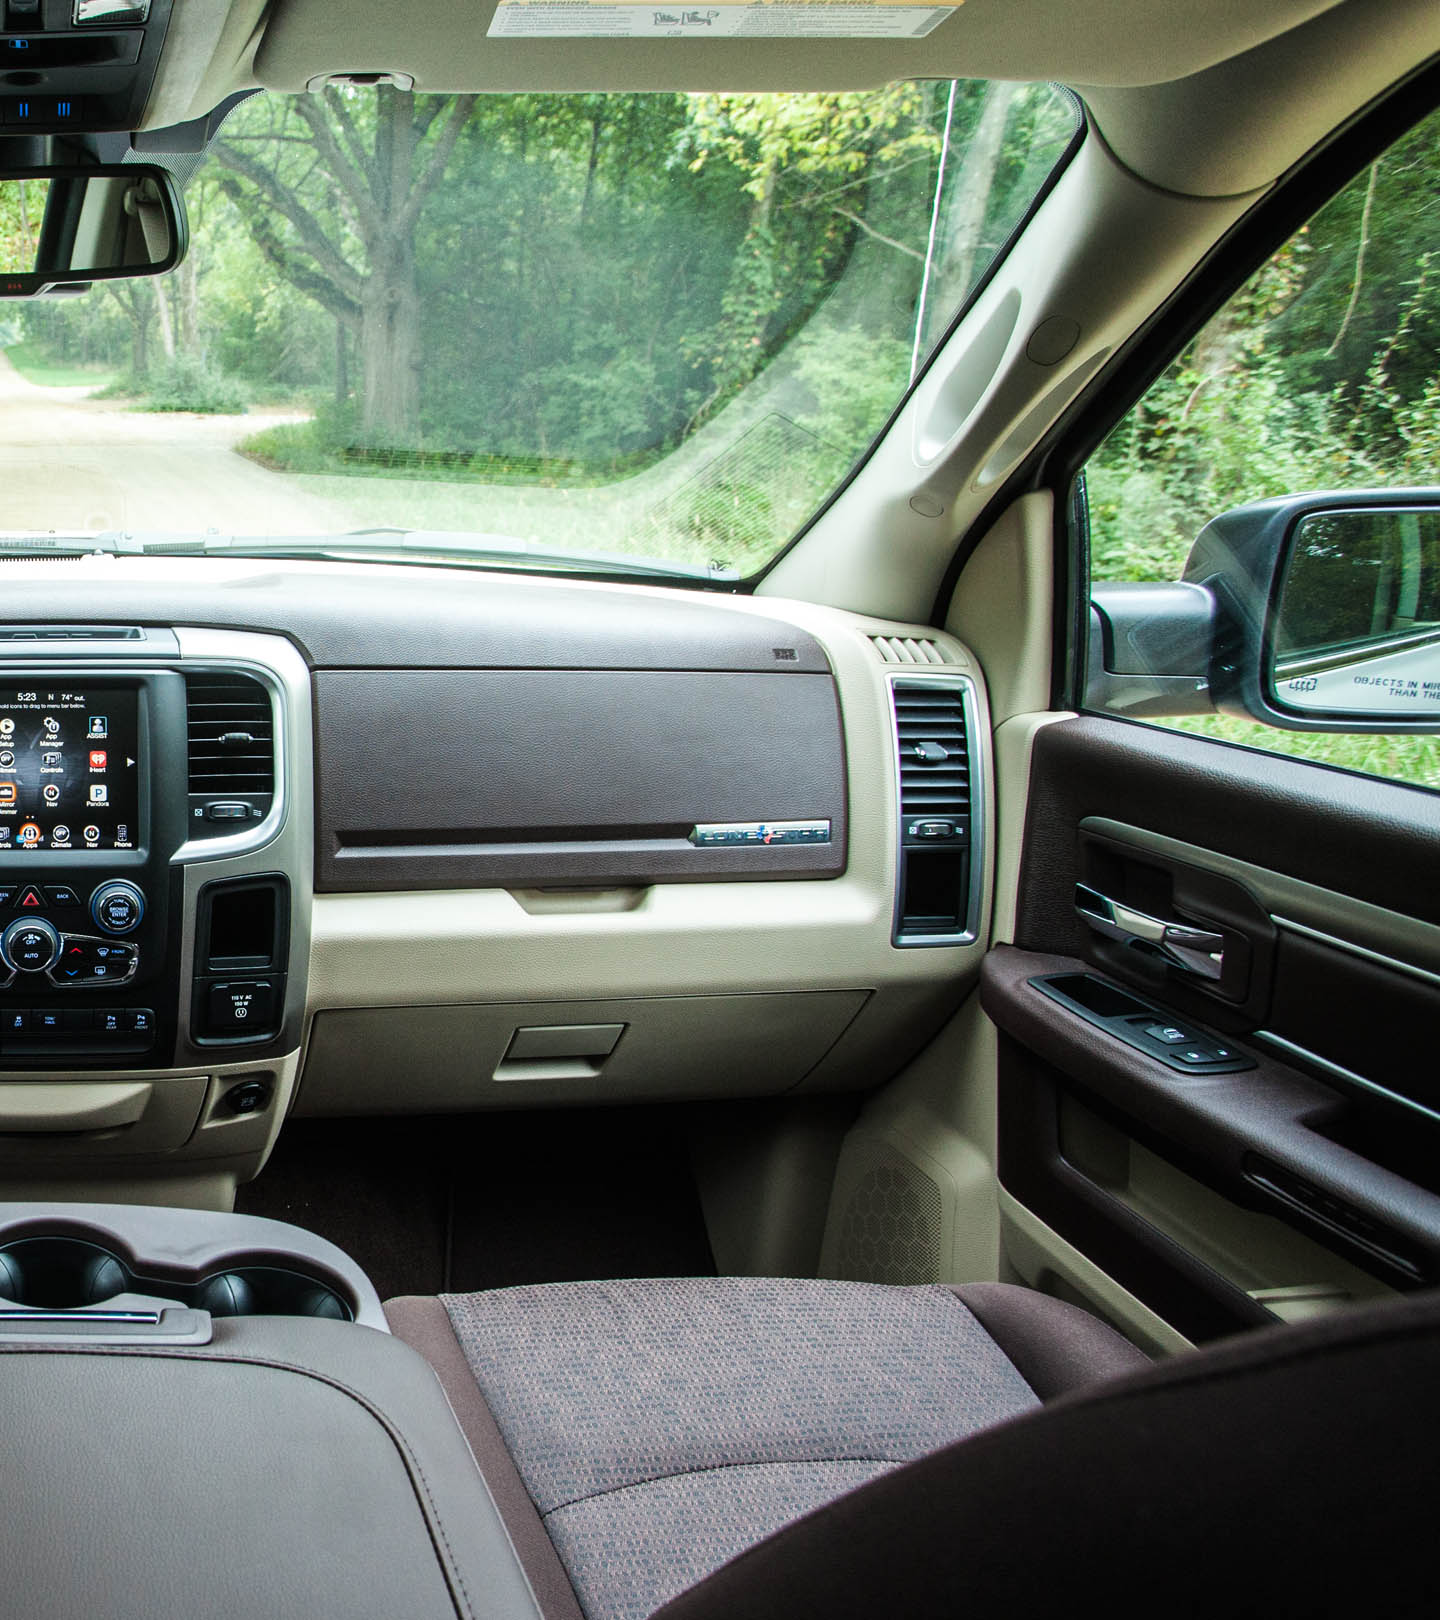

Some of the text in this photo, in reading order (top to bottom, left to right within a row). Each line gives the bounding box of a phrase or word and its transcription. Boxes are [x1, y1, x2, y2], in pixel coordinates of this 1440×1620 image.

[1353, 676, 1404, 688] OBJECTS
[1407, 681, 1418, 689] IN
[17, 692, 37, 701] 5:23
[48, 693, 54, 701] N
[1389, 688, 1417, 697] THAN
[701, 830, 759, 842] LONE
